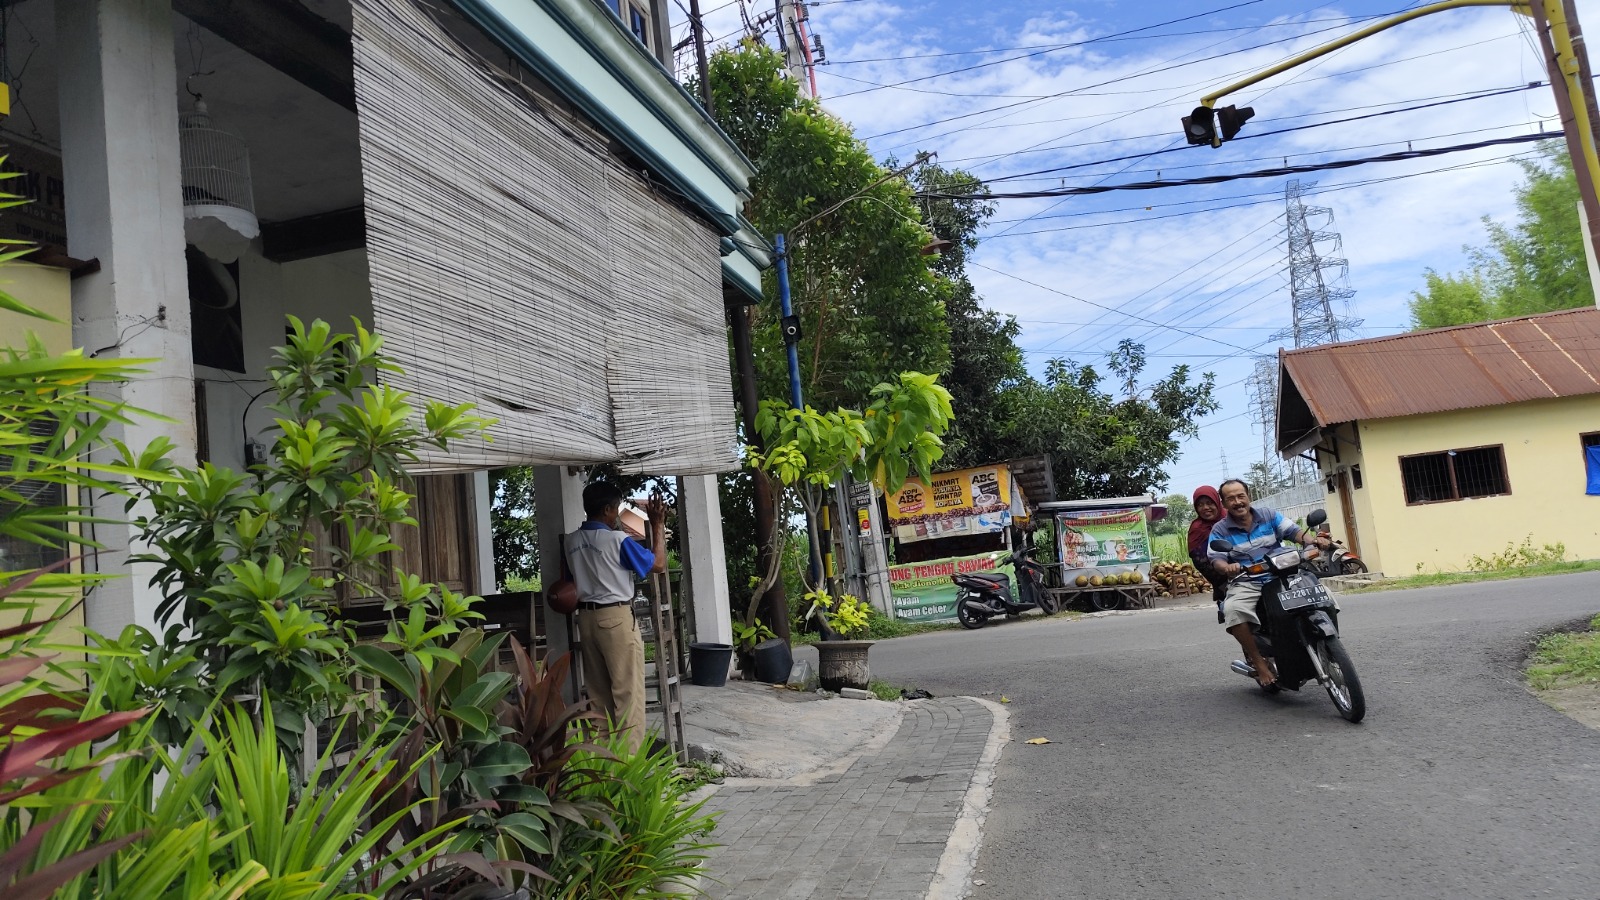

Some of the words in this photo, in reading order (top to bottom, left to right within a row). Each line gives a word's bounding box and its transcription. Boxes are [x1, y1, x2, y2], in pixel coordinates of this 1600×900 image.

[931, 477, 960, 488] NIKMAT
[972, 472, 995, 485] ABC
[902, 488, 918, 496] KOPI
[933, 491, 962, 502] MANTAP
[898, 493, 922, 505] ABC
[935, 498, 963, 509] KOPINYA
[889, 567, 912, 582] UNG
[914, 562, 955, 579] TENGAH
[957, 557, 996, 573] SAWAH
[893, 581, 911, 590] Pak
[896, 596, 920, 606] Ayam
[1281, 592, 1290, 601] AC
[898, 608, 921, 618] Ayam
[922, 604, 947, 615] Ceker
